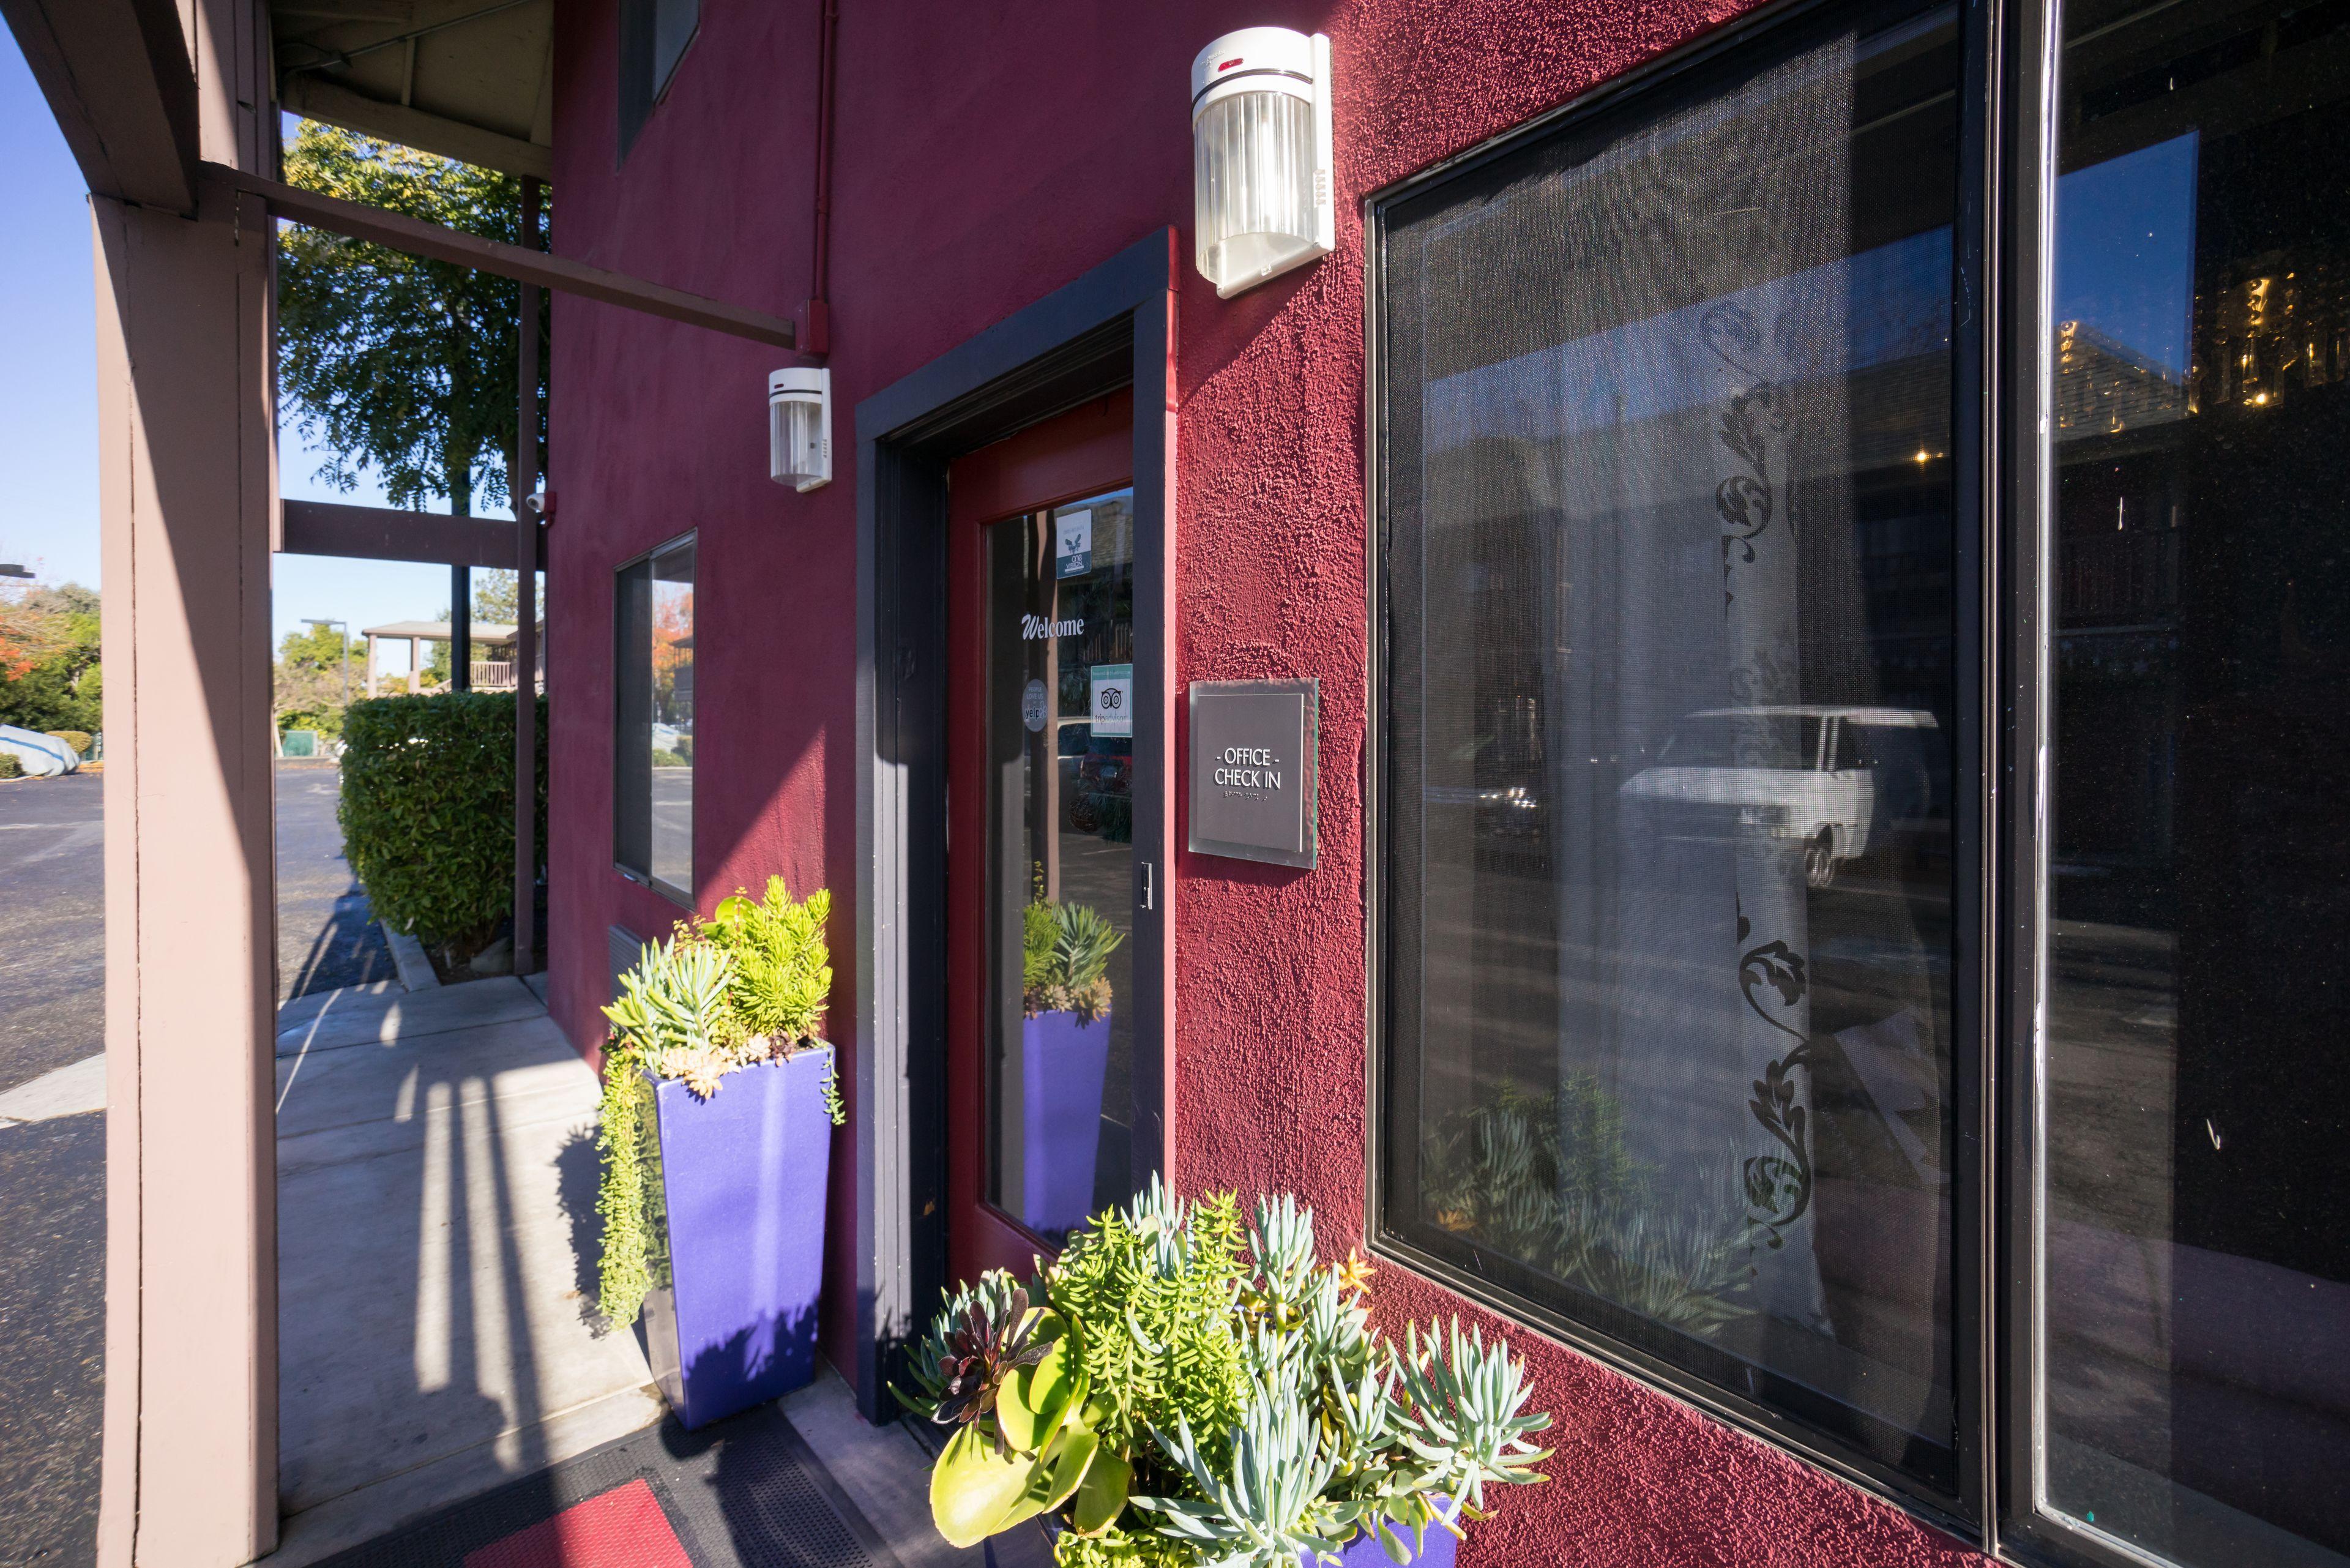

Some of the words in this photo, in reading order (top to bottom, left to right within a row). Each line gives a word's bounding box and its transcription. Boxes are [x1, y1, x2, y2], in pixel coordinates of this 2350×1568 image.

[1065, 561, 1083, 569] VISION
[1021, 613, 1084, 640] Welcome
[1025, 706, 1040, 720] yelp
[1095, 711, 1128, 725] tripadvisor
[1225, 747, 1270, 766] OFFICE
[1215, 768, 1260, 788] CHECK
[1265, 771, 1281, 790] IN
